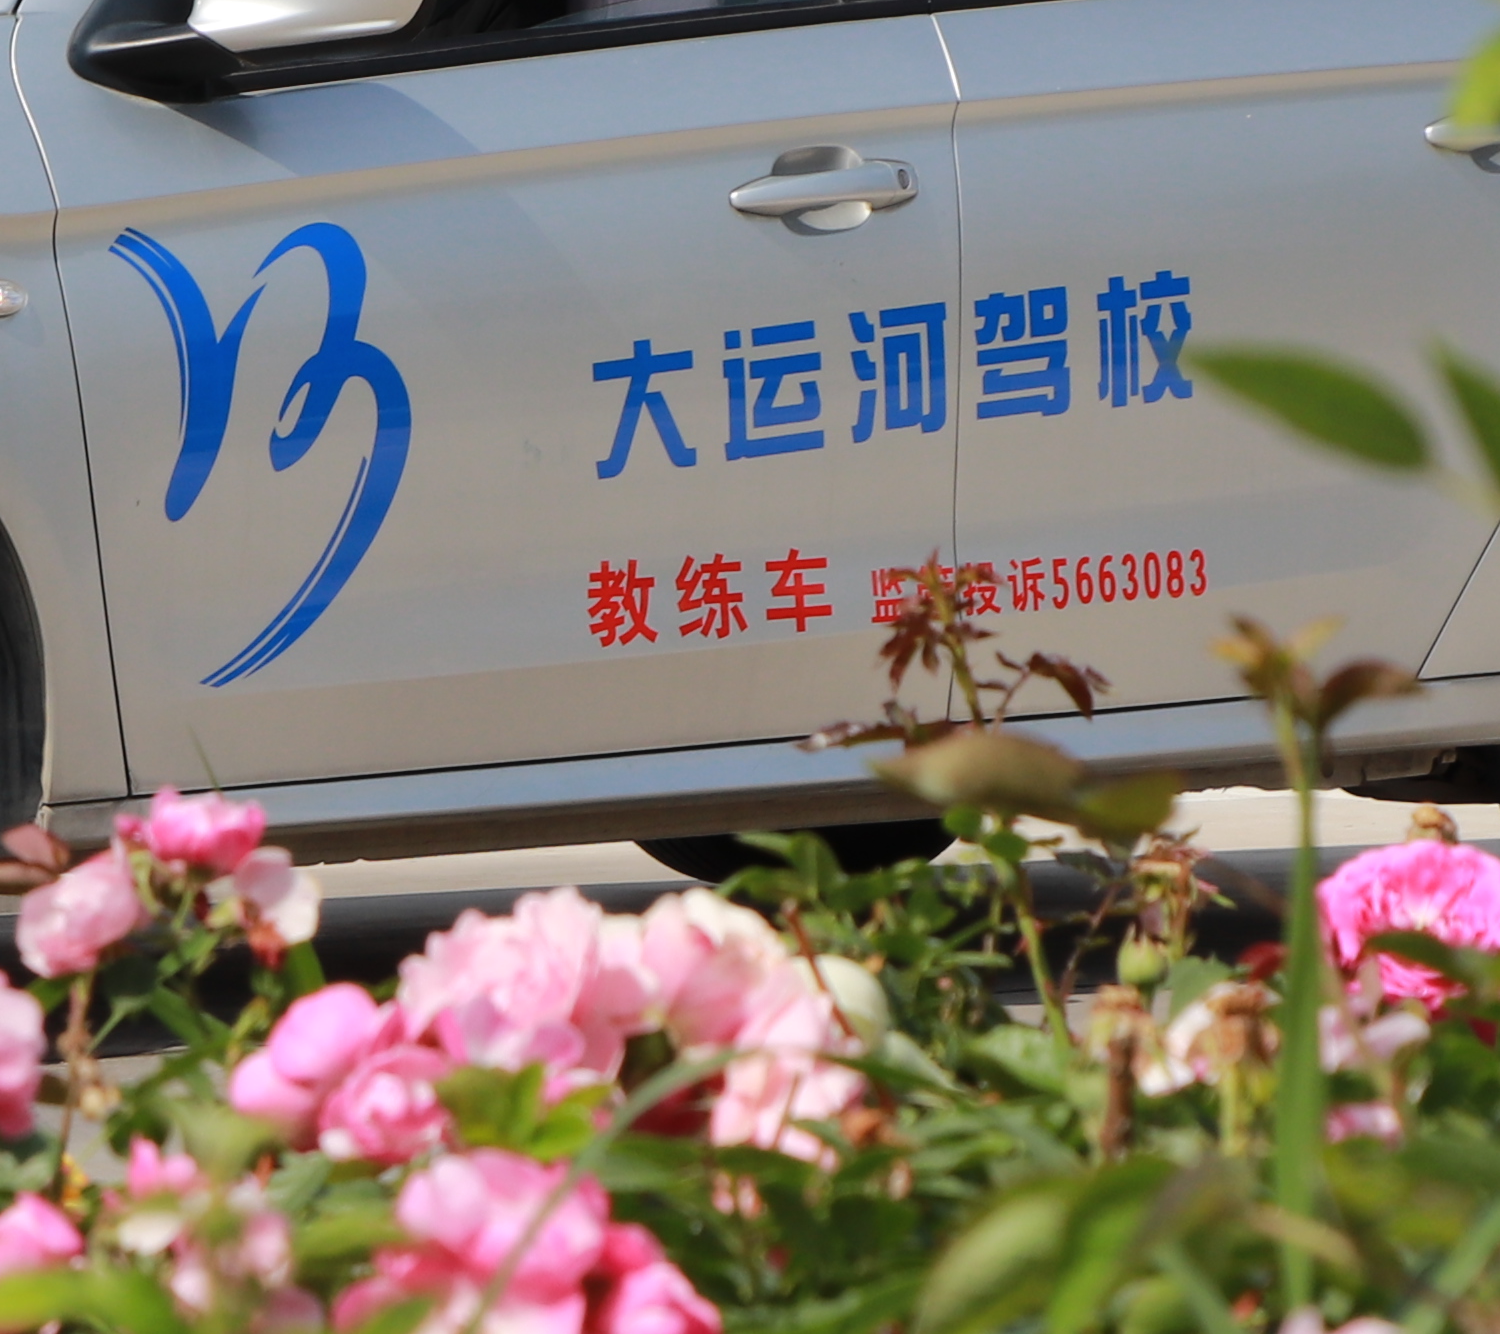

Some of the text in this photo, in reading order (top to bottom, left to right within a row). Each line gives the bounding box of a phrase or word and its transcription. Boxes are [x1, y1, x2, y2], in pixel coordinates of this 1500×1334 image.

[592, 270, 1193, 480] 大运河驾校
[587, 549, 832, 647] 教练车
